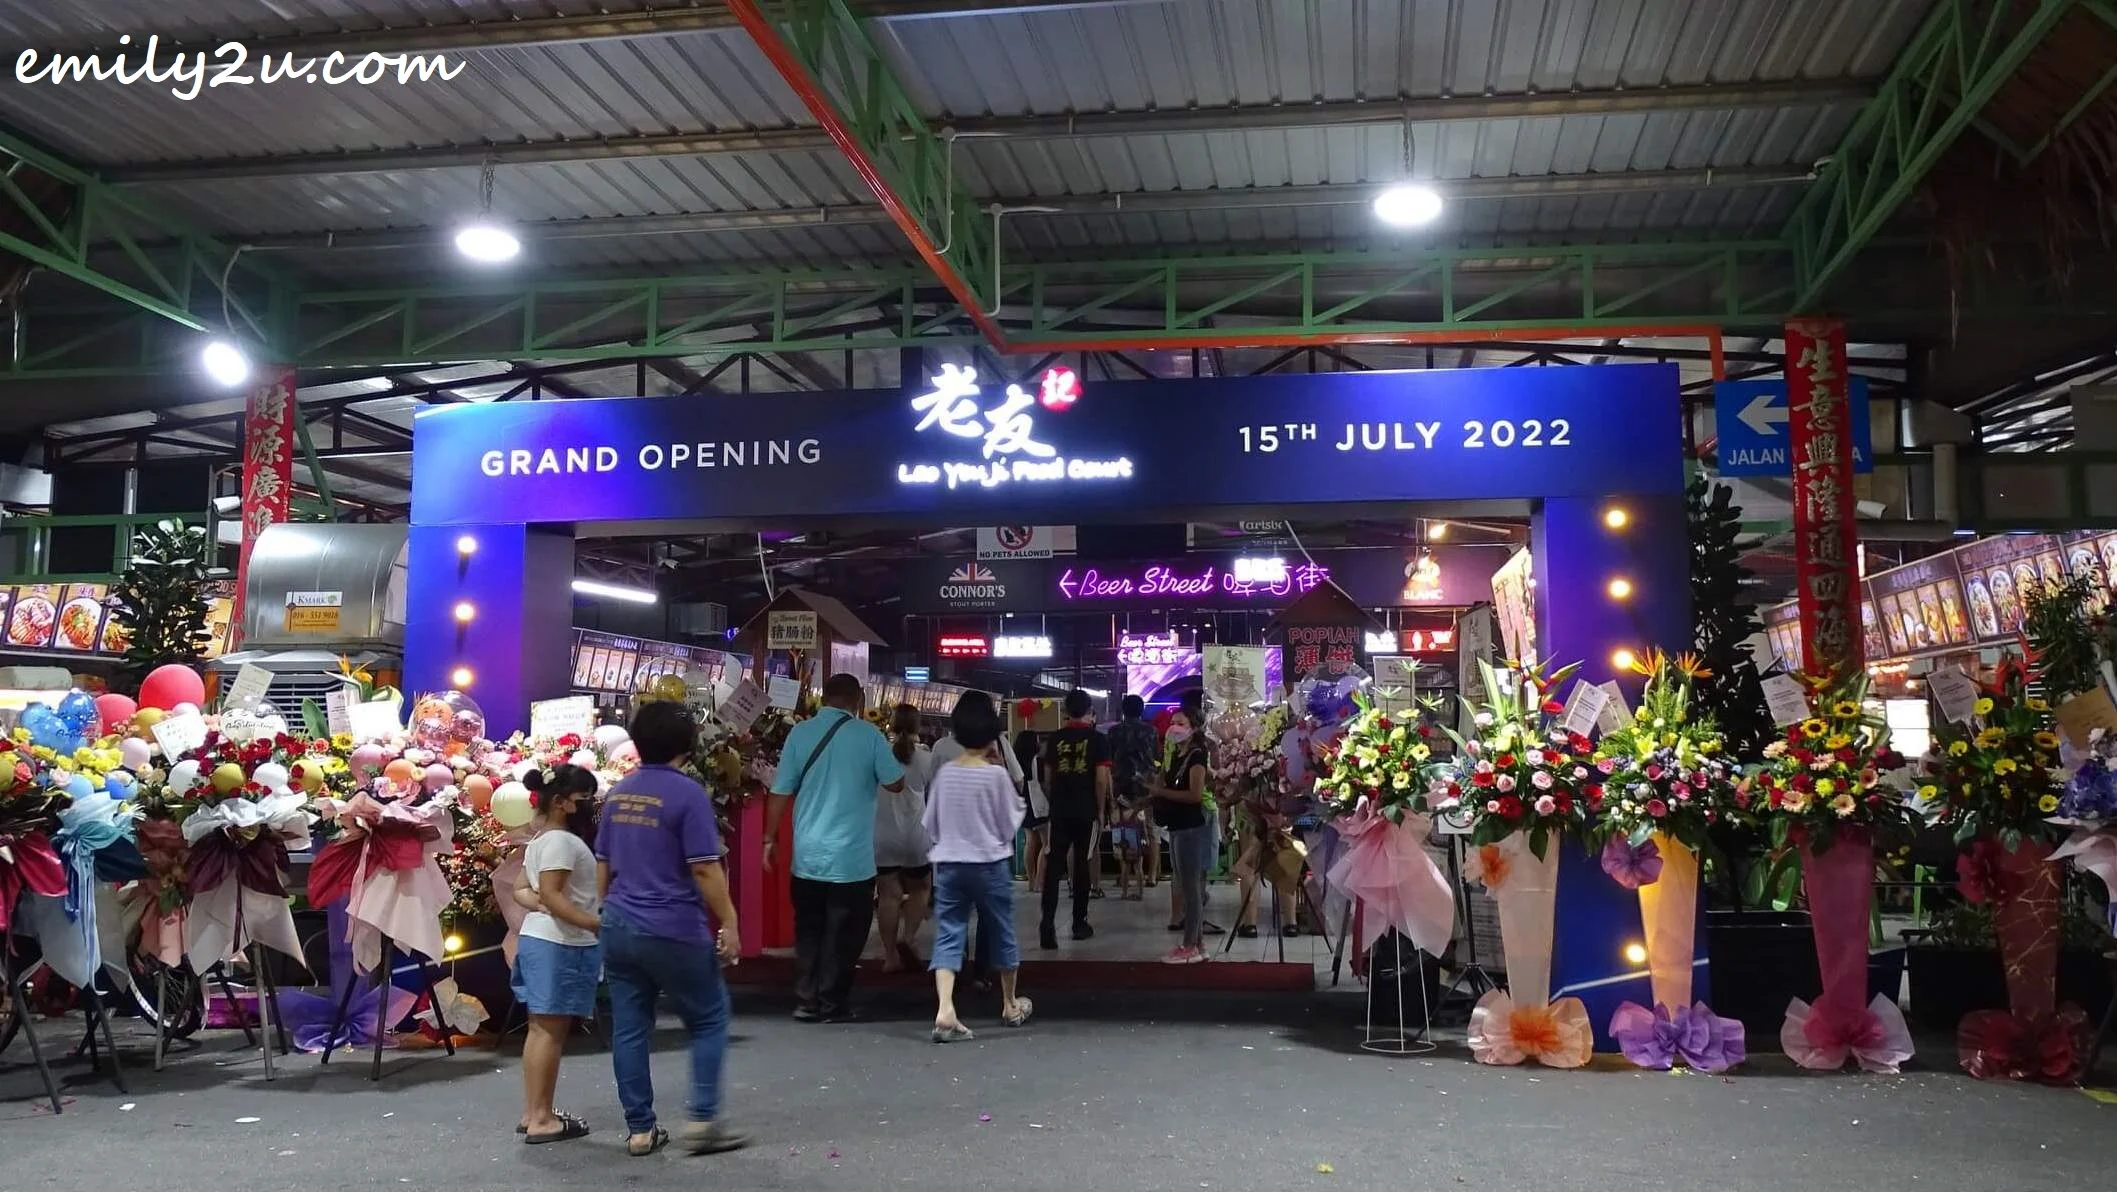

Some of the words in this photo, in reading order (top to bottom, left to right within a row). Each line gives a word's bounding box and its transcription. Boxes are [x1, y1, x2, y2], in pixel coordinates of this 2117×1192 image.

[1239, 423, 1317, 452] 15TH
[1336, 421, 1441, 450] JULY
[1463, 419, 1571, 448] 2022
[481, 446, 618, 477] GRAND
[638, 439, 821, 470] OPENING
[1728, 448, 1785, 465] JALAN
[1012, 457, 1064, 480] Food
[1068, 457, 1133, 479] Court
[1014, 549, 1050, 557] ALLOWED
[940, 585, 1006, 598] CONNOR'S
[1079, 569, 1133, 596] Beer
[1138, 566, 1214, 594] Street
[1288, 625, 1361, 645] POPIAH
